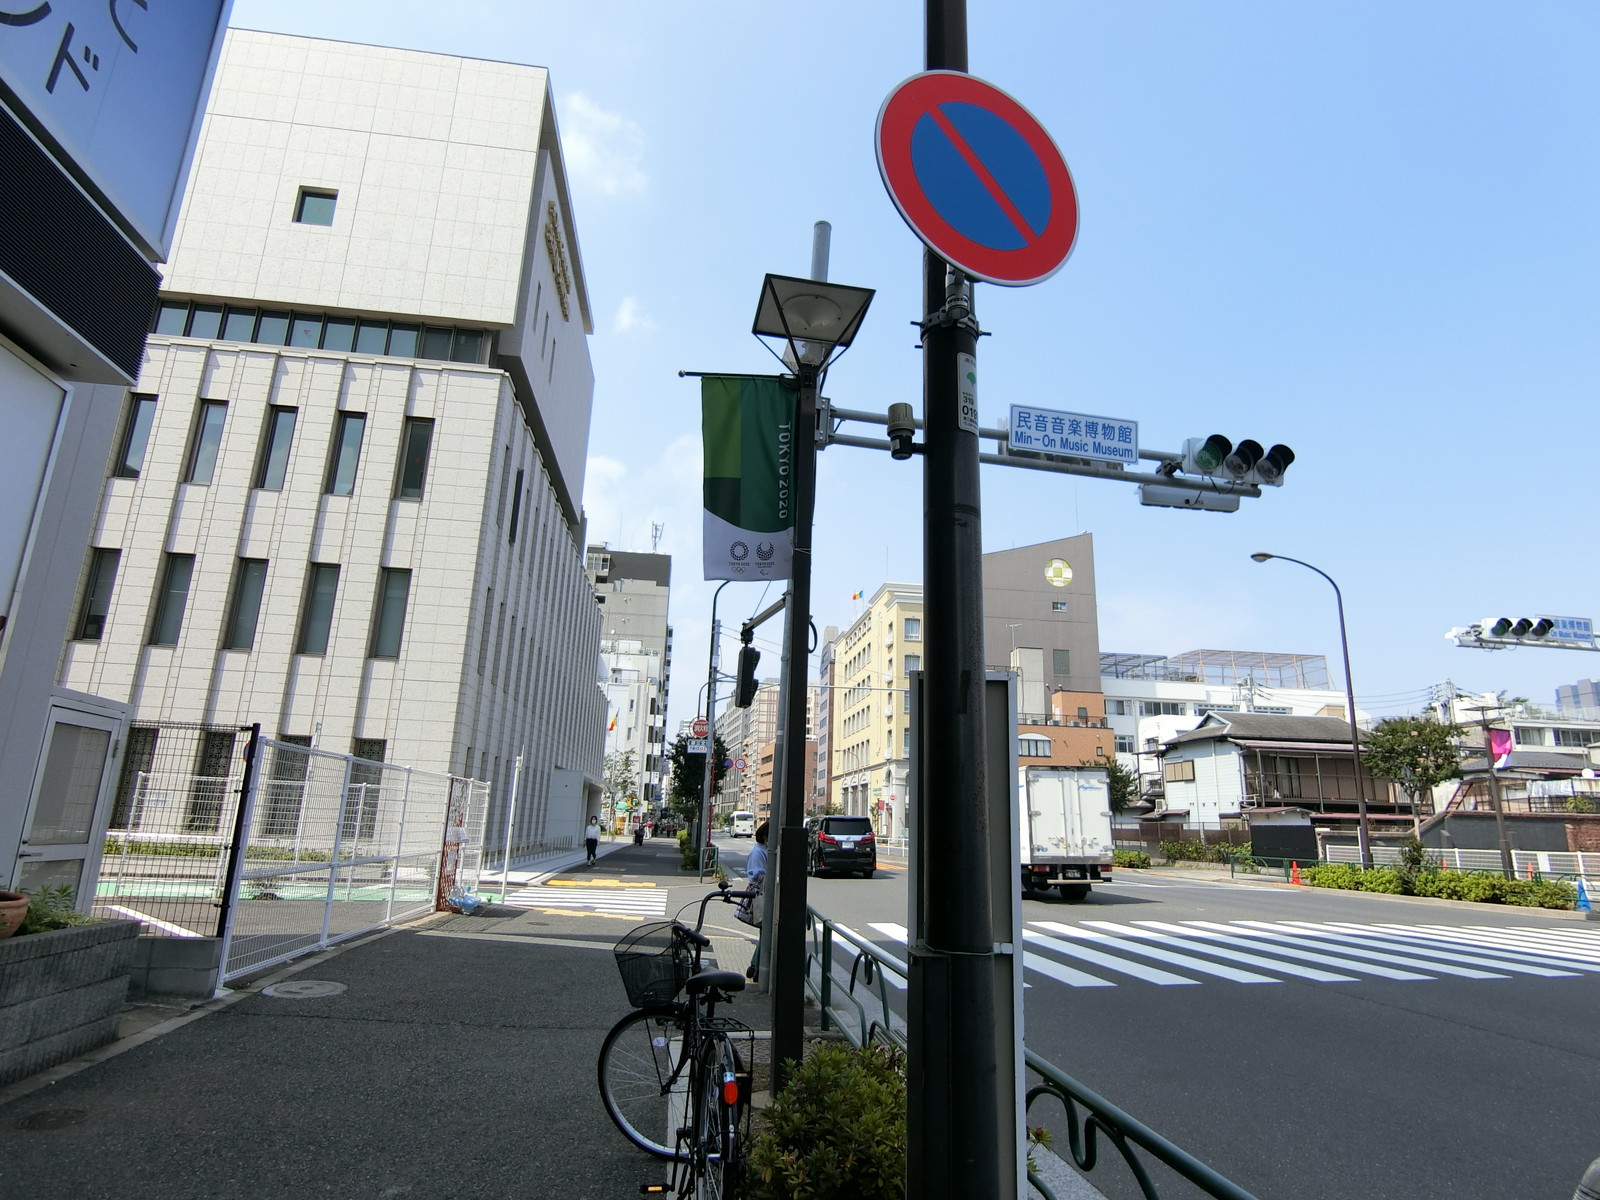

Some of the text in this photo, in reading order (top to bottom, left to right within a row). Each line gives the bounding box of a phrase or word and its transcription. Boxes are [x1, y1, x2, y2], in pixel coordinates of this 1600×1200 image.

[1016, 411, 1133, 444] 民音音楽博物館
[1015, 430, 1133, 459] Min-On Music Museum
[778, 421, 791, 519] TOKYO 2020
